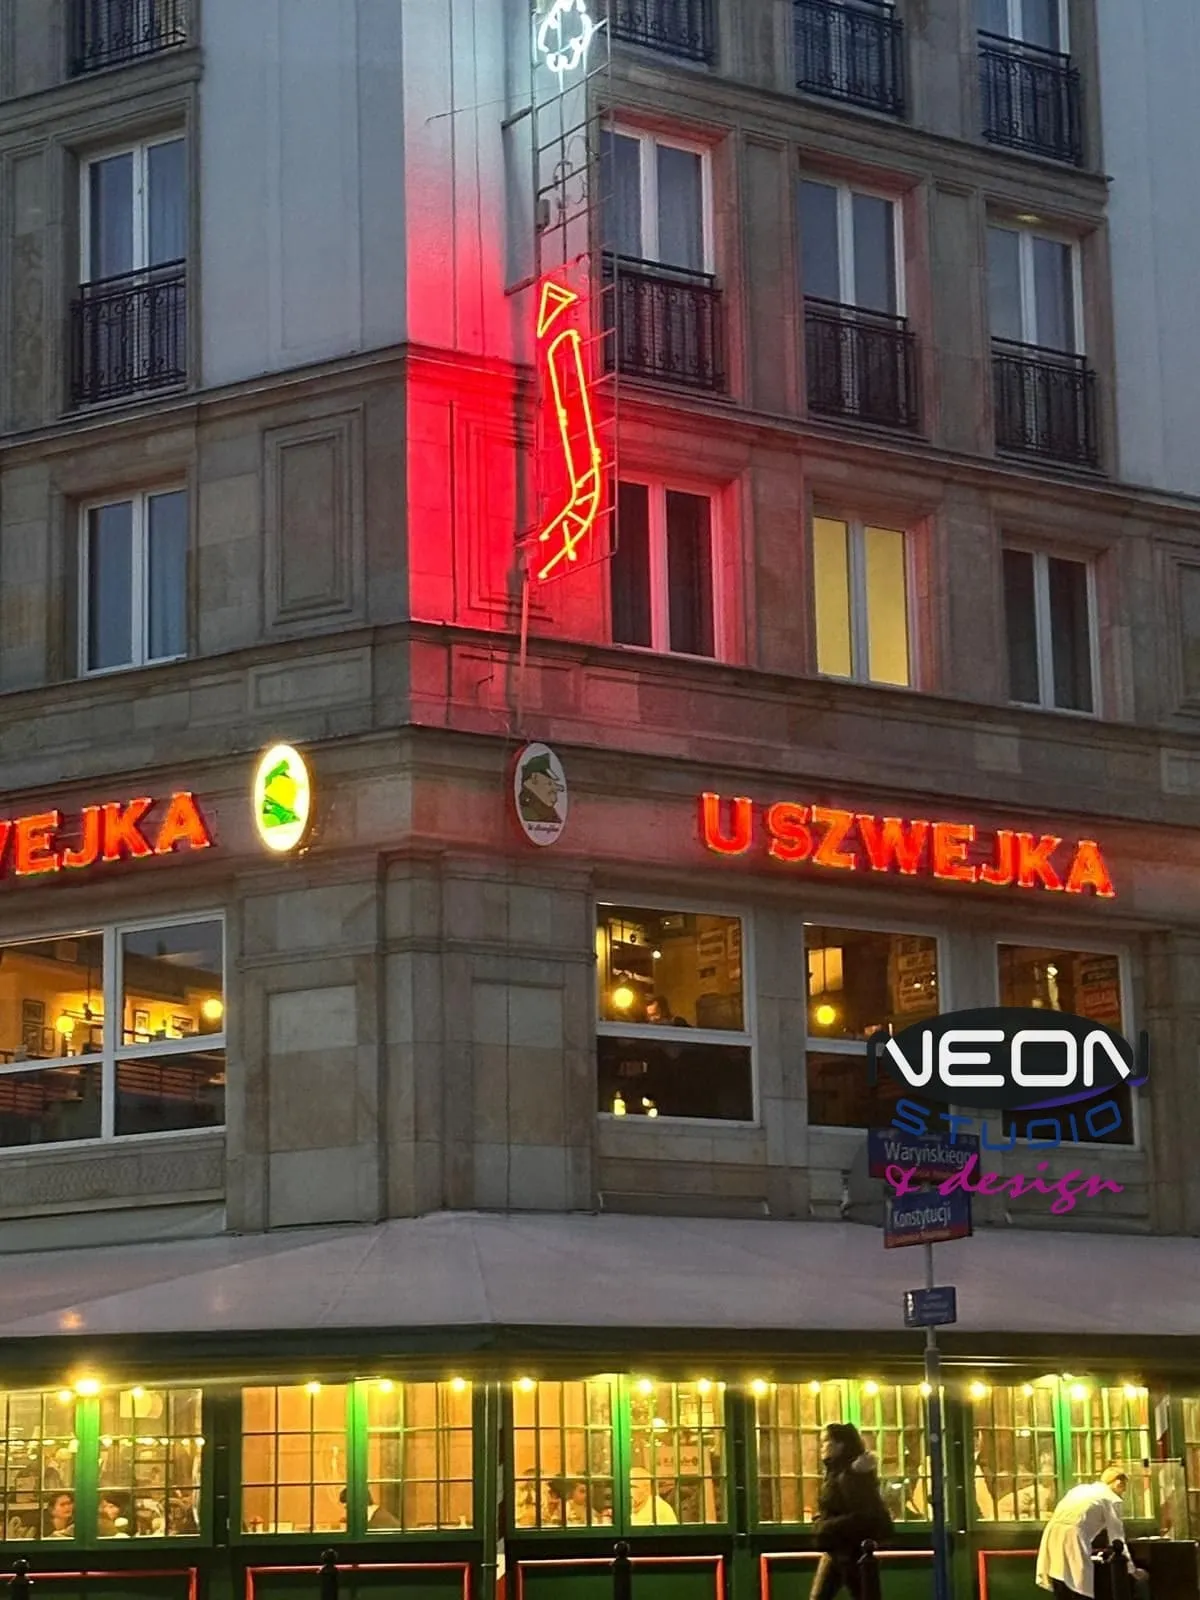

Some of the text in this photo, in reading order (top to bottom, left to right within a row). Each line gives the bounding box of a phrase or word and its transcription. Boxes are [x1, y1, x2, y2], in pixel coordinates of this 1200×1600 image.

[701, 792, 1117, 898] U SZWEJKA
[892, 1201, 952, 1229] Konstytucji
